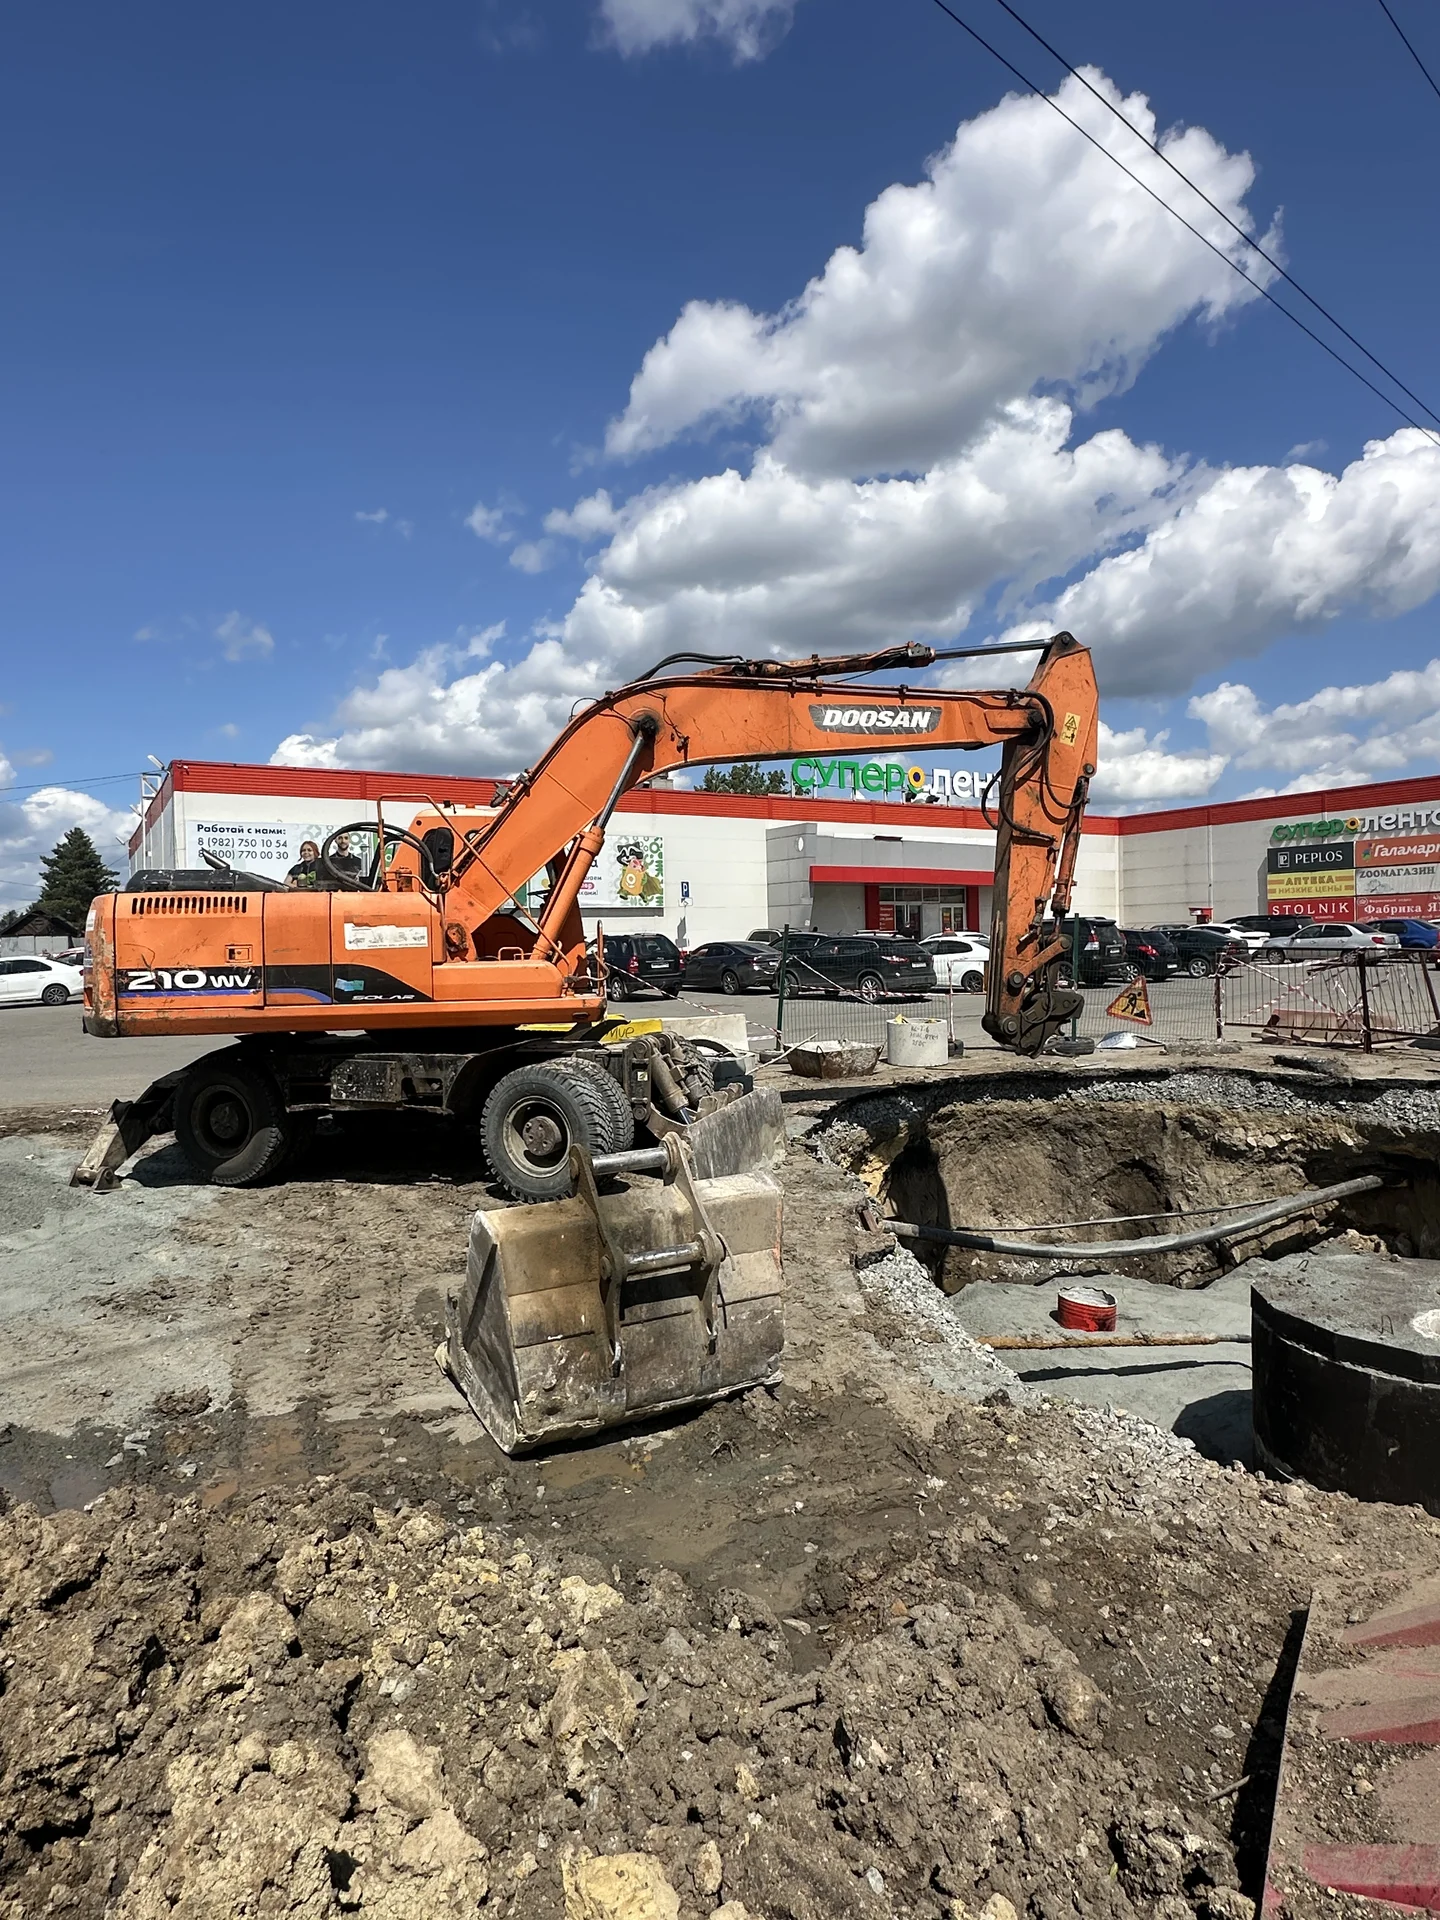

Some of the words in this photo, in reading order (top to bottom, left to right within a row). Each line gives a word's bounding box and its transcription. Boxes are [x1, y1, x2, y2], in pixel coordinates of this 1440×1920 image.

[822, 709, 931, 728] DOOSAN
[791, 757, 905, 792] супер
[197, 824, 244, 834] Работай
[1272, 818, 1345, 841] супер
[197, 837, 204, 846] 8
[207, 837, 235, 848] (982)
[238, 838, 257, 847] 750
[261, 839, 272, 847] 10
[275, 839, 287, 848] 54
[208, 849, 235, 859] 800)
[238, 850, 257, 859] 770
[260, 851, 273, 859] 00
[276, 851, 289, 859] 30
[1295, 850, 1343, 864] PEPLOS
[1285, 875, 1335, 886] АПТЕКА
[1278, 886, 1313, 894] НИЗКИЕ
[1315, 885, 1342, 893] ЦЕНЫ
[1272, 902, 1350, 916] STOLNIK
[1364, 904, 1422, 915] Фабрика
[127, 969, 207, 991] 210
[351, 993, 416, 1001] SOLAR
